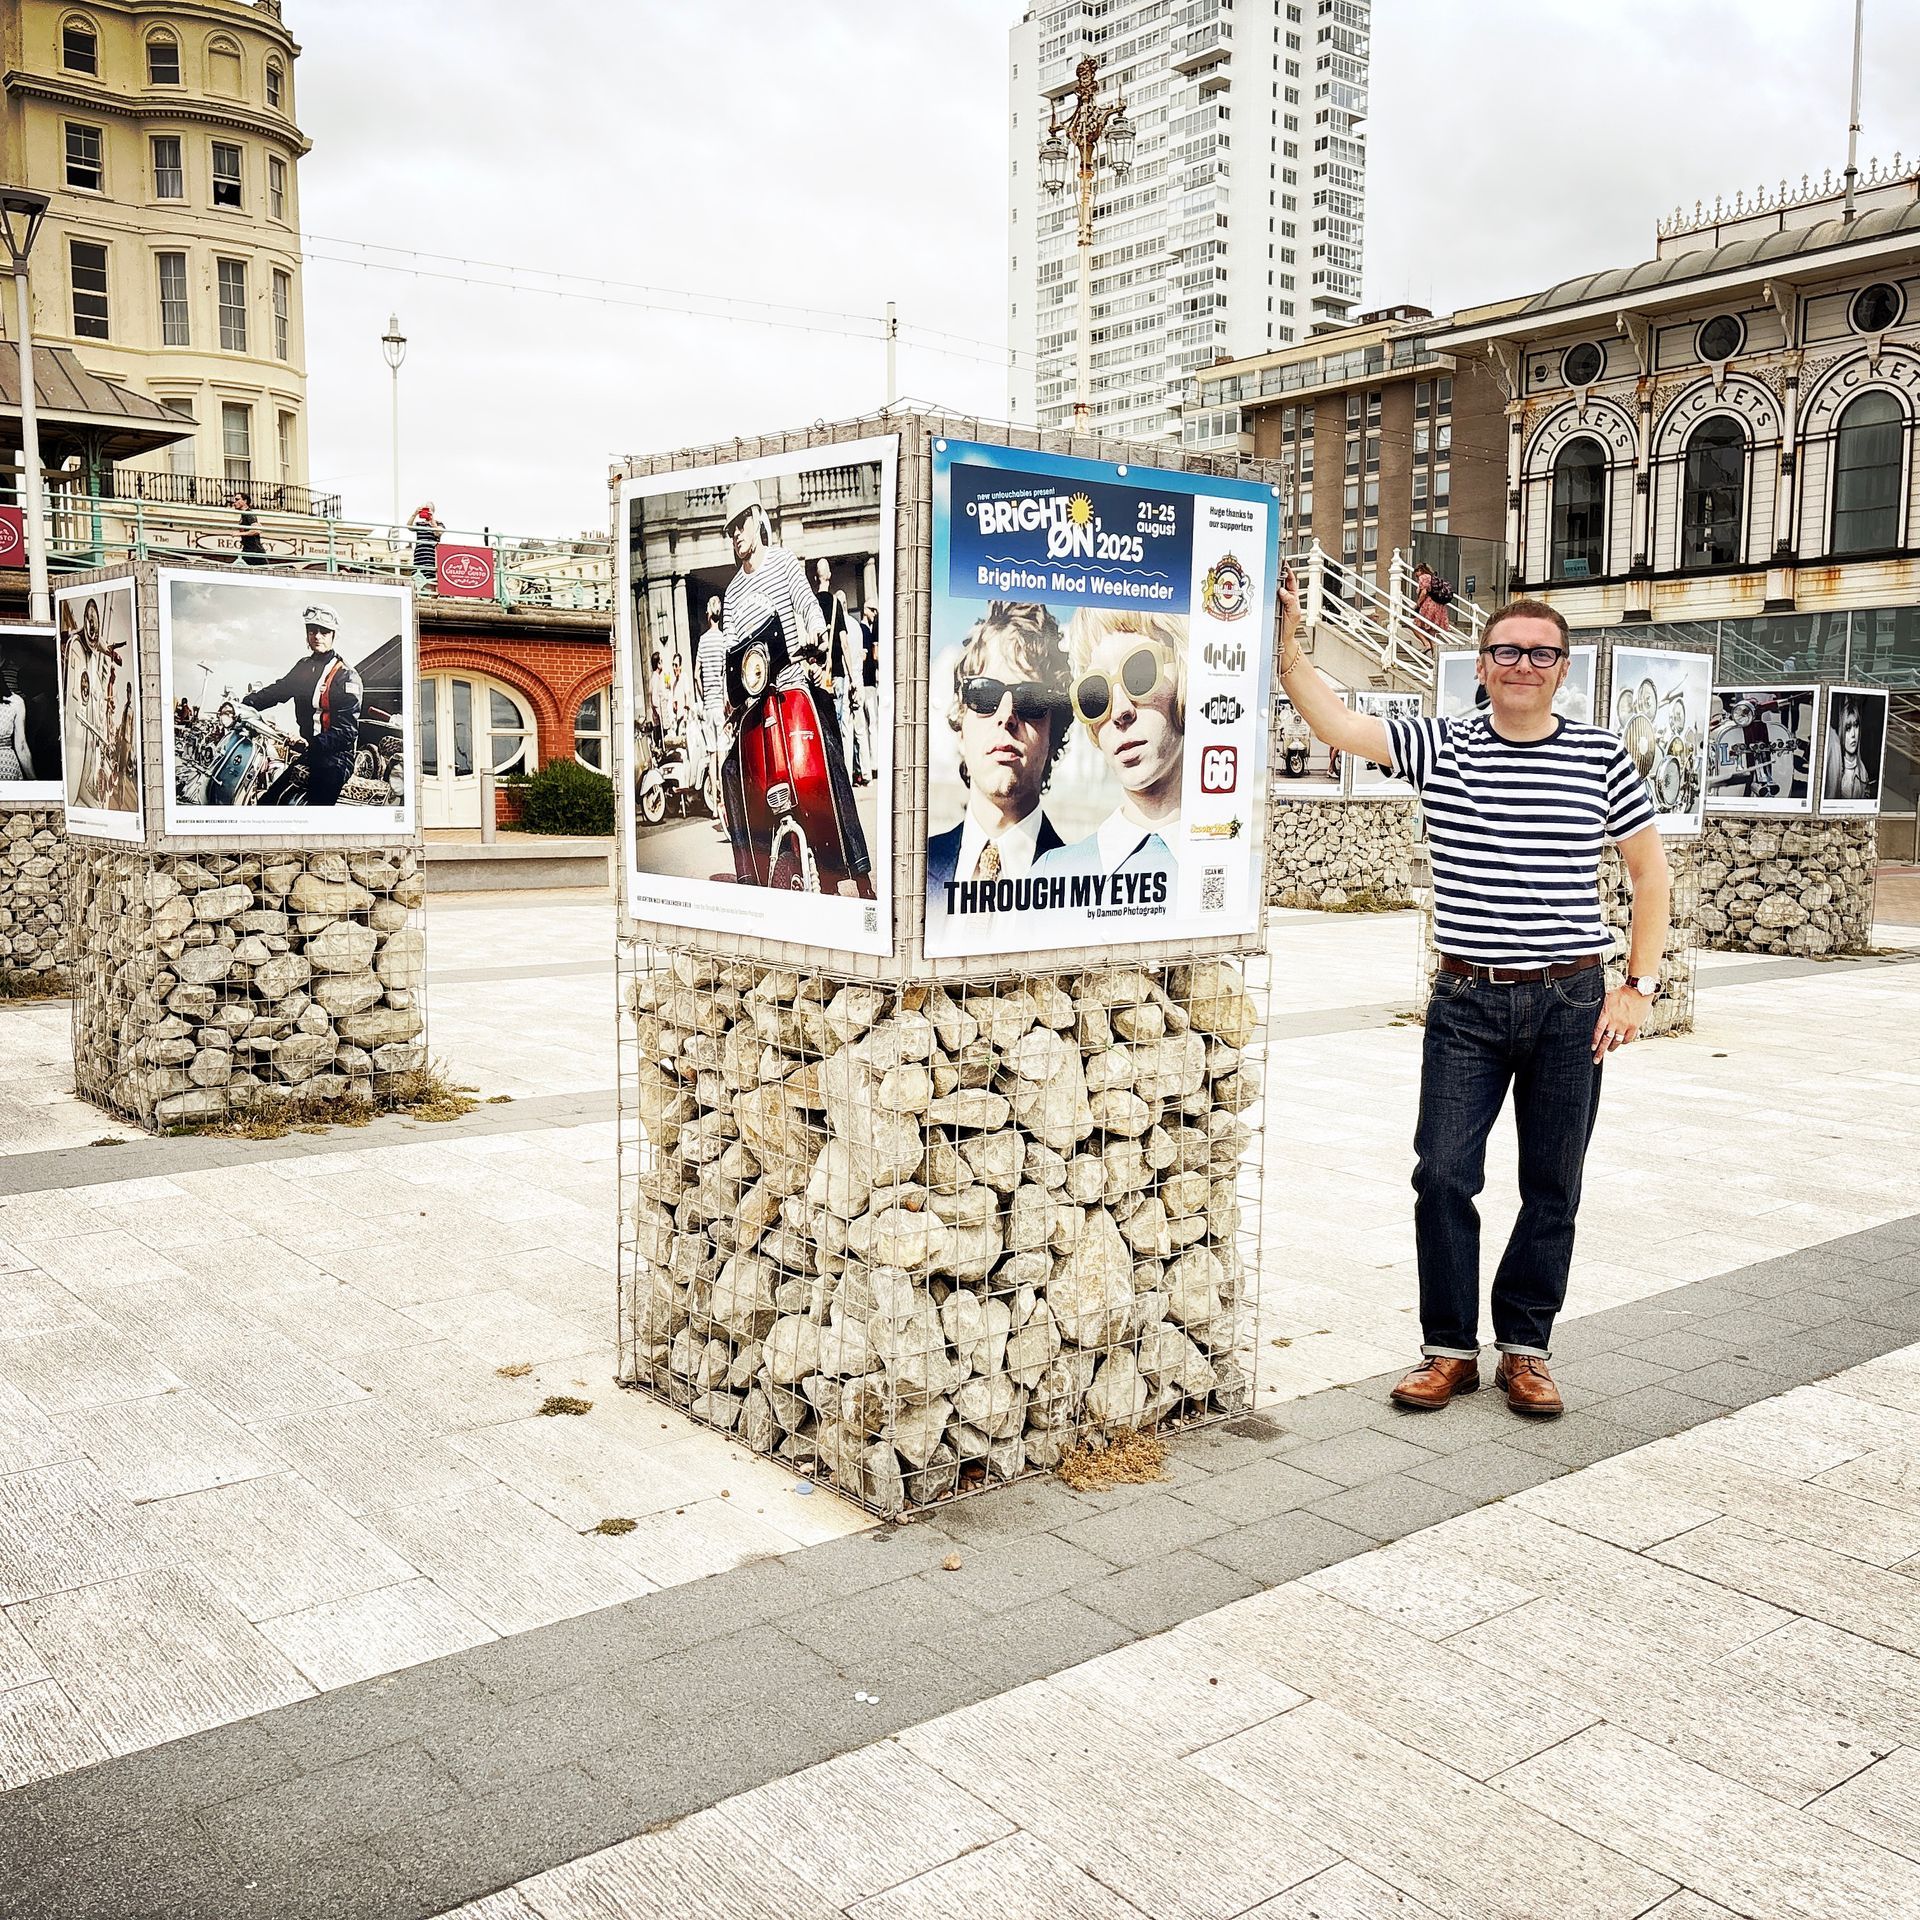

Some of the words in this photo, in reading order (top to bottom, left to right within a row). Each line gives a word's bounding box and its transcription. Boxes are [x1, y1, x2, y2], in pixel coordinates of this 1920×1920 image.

[1668, 386, 1771, 436] TICKETS
[1537, 410, 1628, 455] TICKETS
[991, 489, 1032, 499] untouchables
[1033, 487, 1056, 498] present
[1137, 502, 1176, 522] 21-25
[1210, 506, 1225, 518] Huge
[1226, 508, 1246, 519] thanks
[1247, 510, 1254, 520] to
[1136, 521, 1176, 538] august
[1220, 522, 1253, 532] supporters
[153, 534, 169, 543] The
[1096, 533, 1144, 563] 2025
[977, 566, 1047, 592] Brighton
[1052, 572, 1086, 593] Mod
[1090, 576, 1174, 600] Weekender
[1211, 700, 1236, 721] ace
[1203, 749, 1236, 790] 66
[943, 876, 1066, 915] THROUGH
[1070, 874, 1107, 908] MY
[1111, 871, 1168, 905] EYES
[1087, 909, 1095, 919] by
[1096, 908, 1122, 918] Dammo
[1123, 905, 1167, 917] Photography
